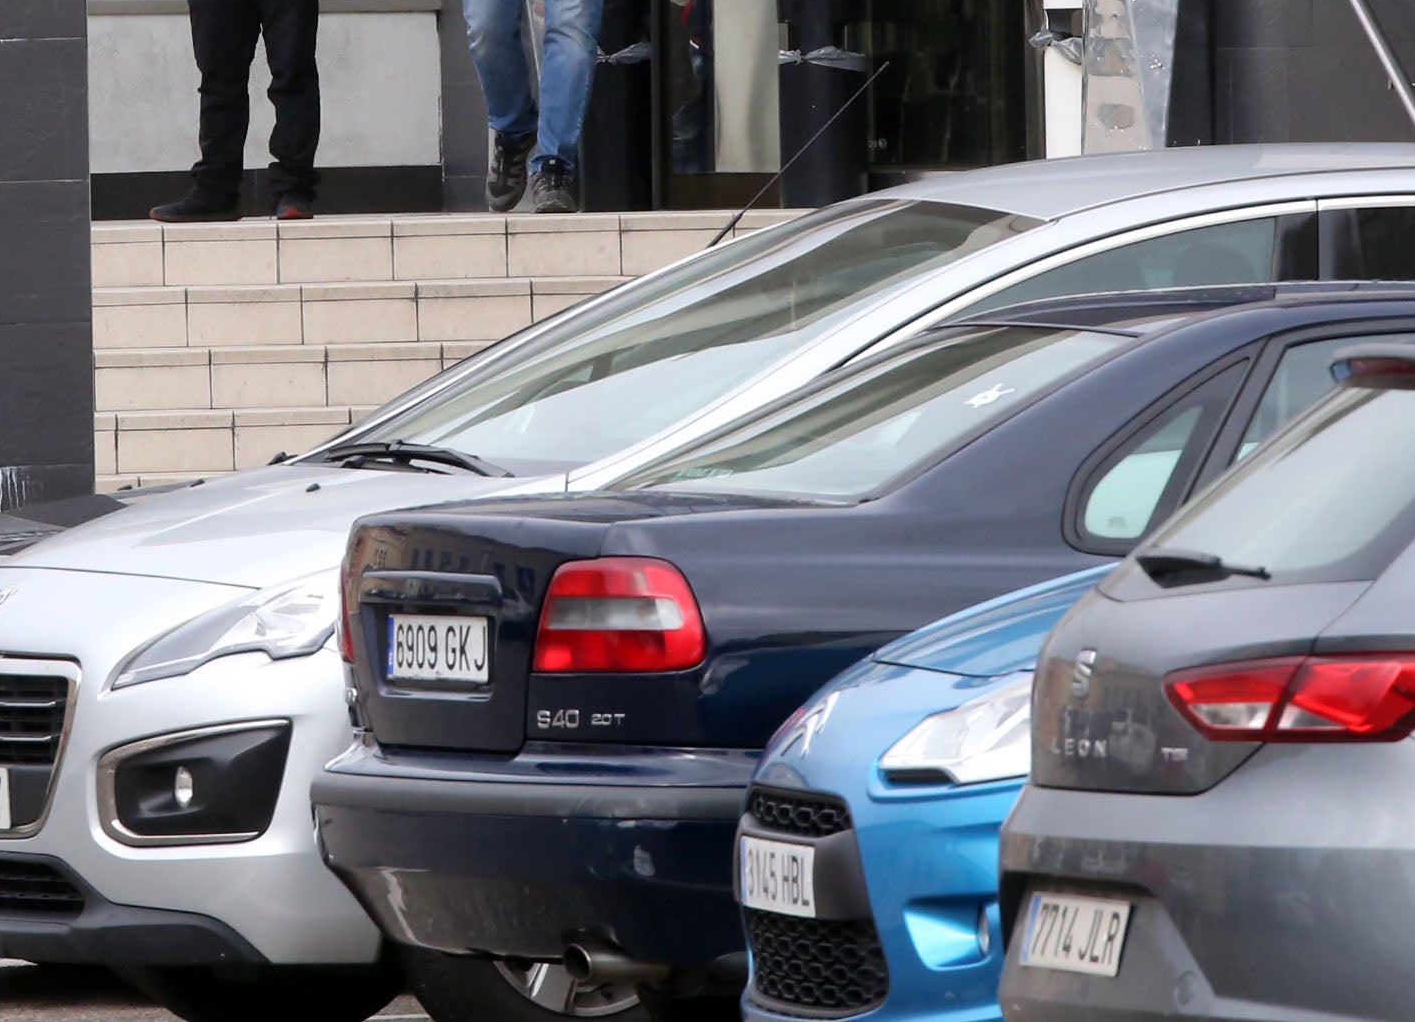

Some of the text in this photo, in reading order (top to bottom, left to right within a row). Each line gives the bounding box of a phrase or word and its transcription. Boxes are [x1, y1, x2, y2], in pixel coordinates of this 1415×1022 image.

[396, 623, 486, 671] 6909 GKJ
[536, 709, 580, 729] S40
[1051, 735, 1107, 758] LEON
[747, 848, 810, 907] 3145 HBL
[1031, 902, 1121, 964] 7714 JLR
